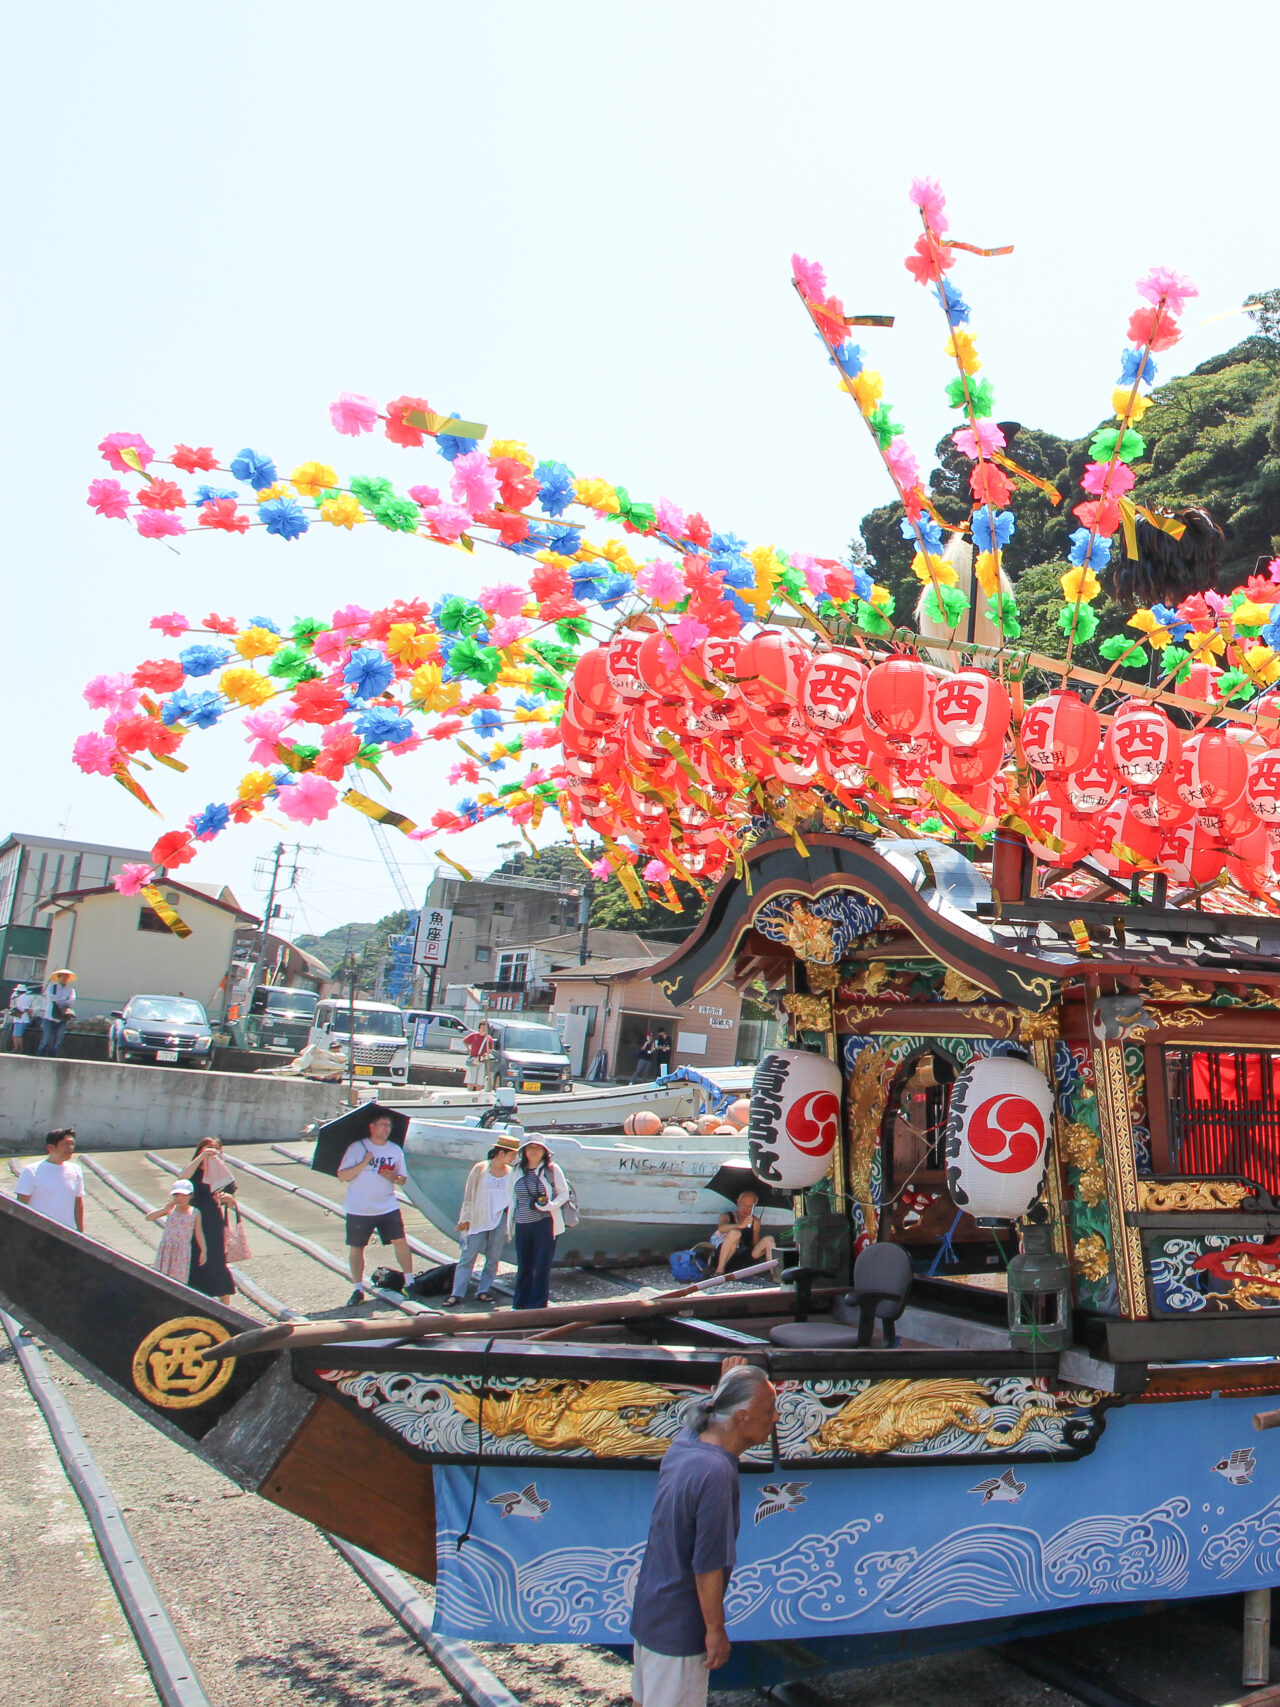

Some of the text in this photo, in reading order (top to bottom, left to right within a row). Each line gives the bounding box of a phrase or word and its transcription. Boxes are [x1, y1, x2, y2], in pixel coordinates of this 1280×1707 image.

[809, 664, 861, 712] 西
[936, 680, 984, 725] 西
[1022, 707, 1054, 749] 西
[1115, 719, 1165, 761] 西
[427, 911, 443, 941] 魚座
[149, 1332, 218, 1393] 西
